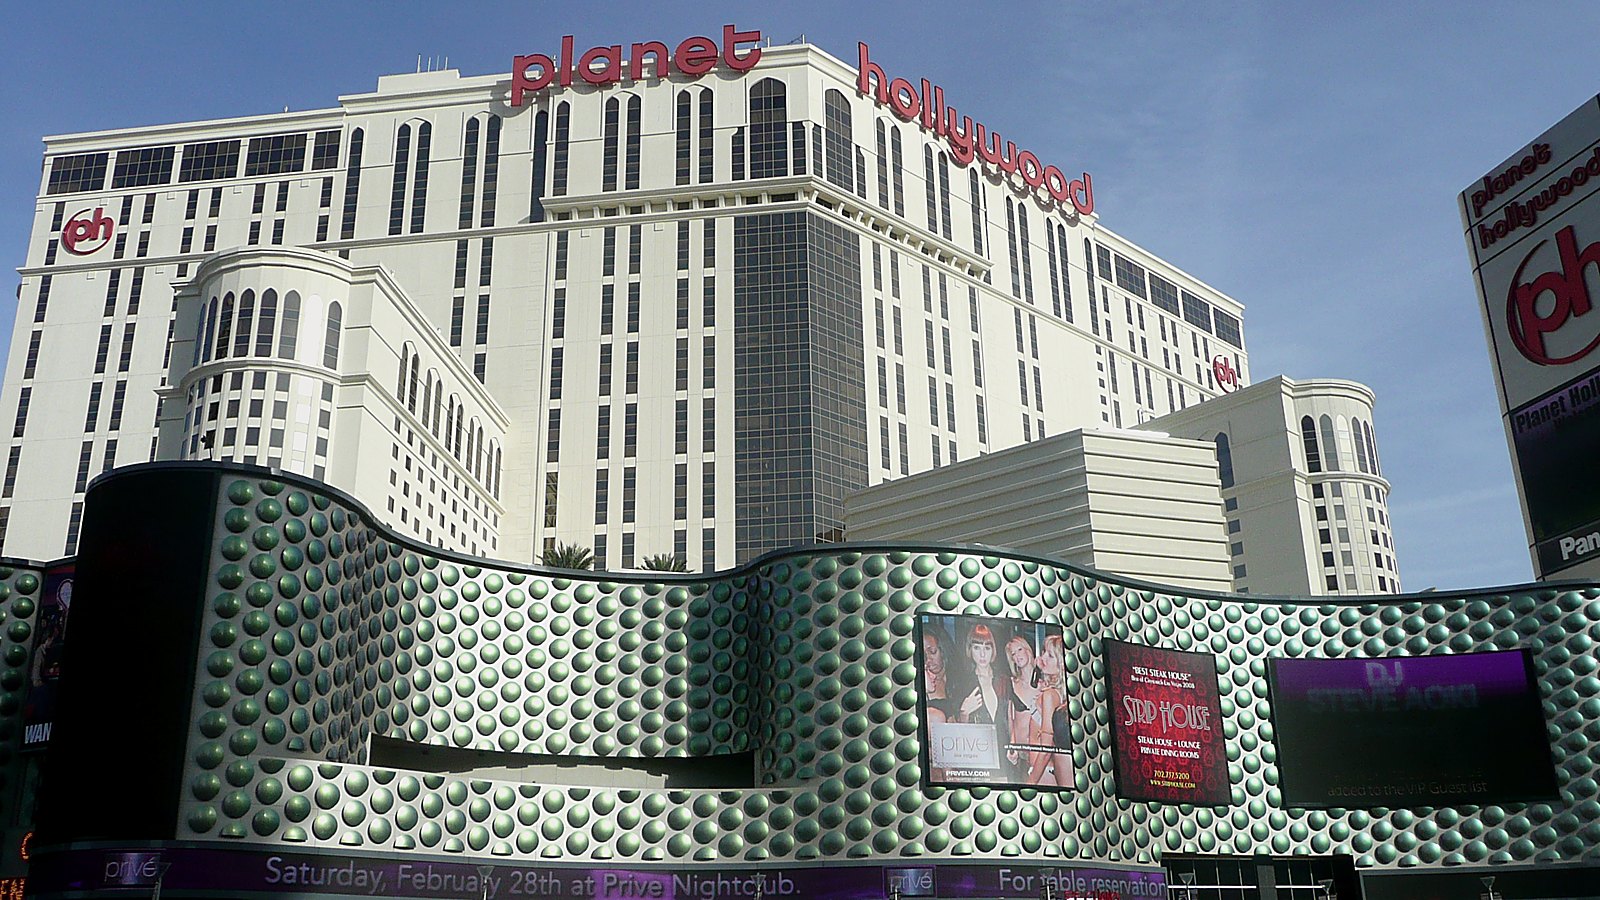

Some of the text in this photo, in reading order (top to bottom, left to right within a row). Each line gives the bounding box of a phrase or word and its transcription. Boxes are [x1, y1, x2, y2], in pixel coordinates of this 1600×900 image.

[511, 25, 1093, 215] planet hollywood
[1471, 143, 1552, 218] planet
[1478, 147, 1600, 249] hollywood
[1516, 396, 1567, 433] Planet
[1559, 532, 1600, 560] Pan
[1149, 669, 1167, 680] STEAK
[1365, 662, 1404, 688] DJ
[1159, 700, 1211, 734] HOUSE
[1137, 735, 1201, 749] STEAK HOUSE LOUNGE
[1140, 746, 1200, 759] PRIVATE DINING ROOMS
[104, 857, 157, 882] privé
[264, 856, 386, 894] Saturday,
[510, 871, 561, 895] 28th
[571, 875, 595, 896] at
[604, 873, 663, 897] Prive
[999, 869, 1035, 891] For
[1091, 876, 1166, 896] reservation
